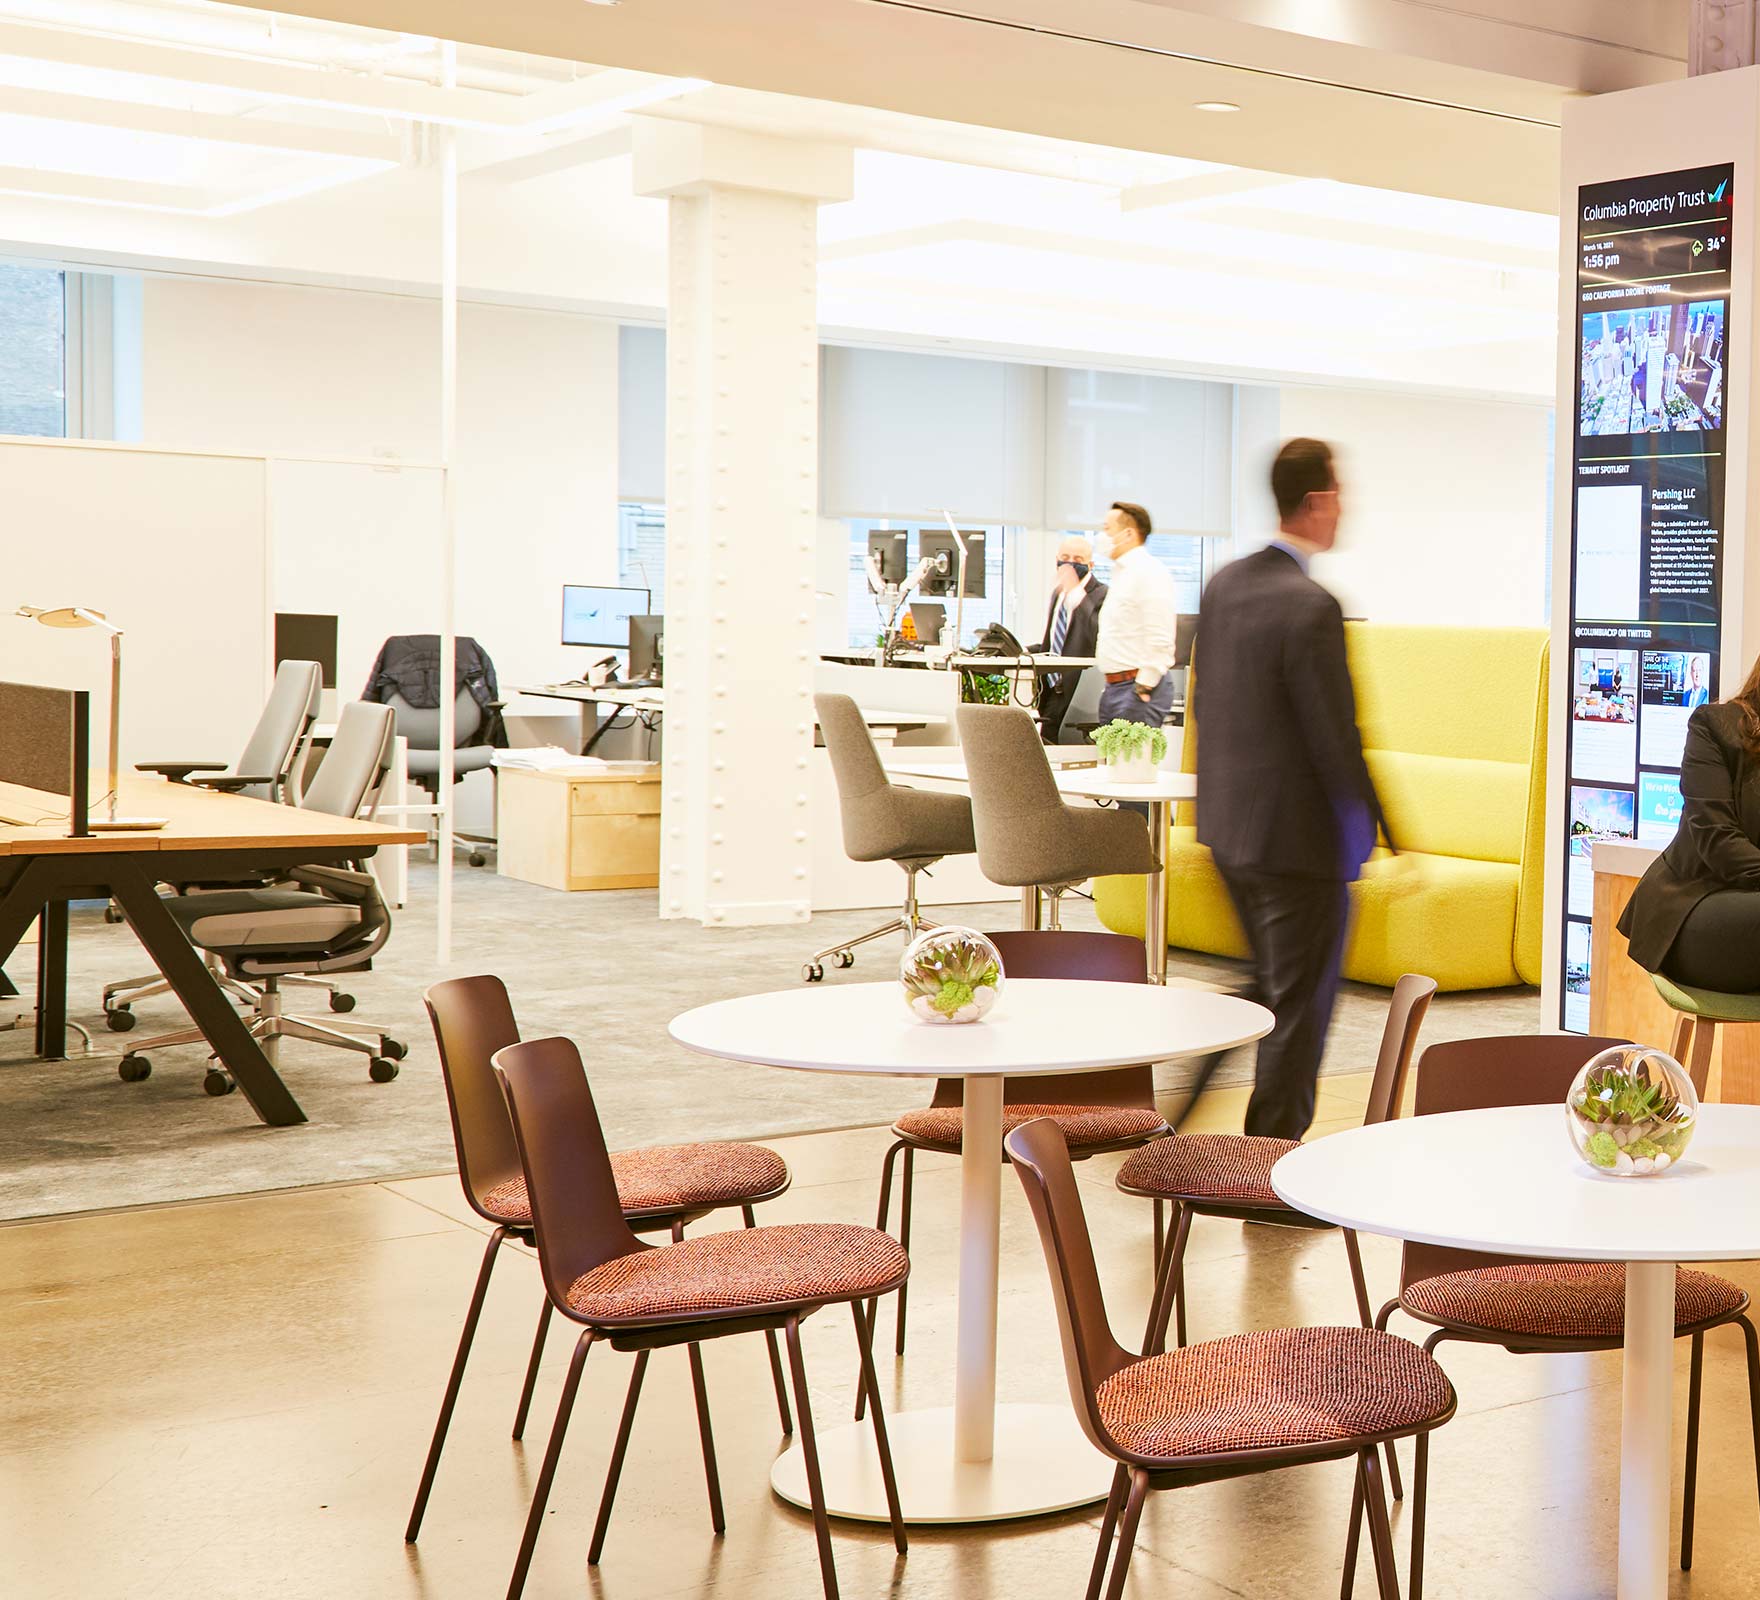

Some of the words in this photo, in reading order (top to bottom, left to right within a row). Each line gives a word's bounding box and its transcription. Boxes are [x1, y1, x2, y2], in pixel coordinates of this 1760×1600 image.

[1583, 203, 1626, 221] Columbia
[1629, 195, 1675, 216] Property
[1677, 189, 1705, 208] Trust
[1583, 254, 1604, 268] 1:56
[1605, 254, 1620, 269] pm
[1600, 465, 1630, 474] SPOTLIGHT
[1652, 489, 1682, 501] Pershing
[1683, 488, 1696, 499] LLC
[1627, 629, 1651, 638] TWITTER
